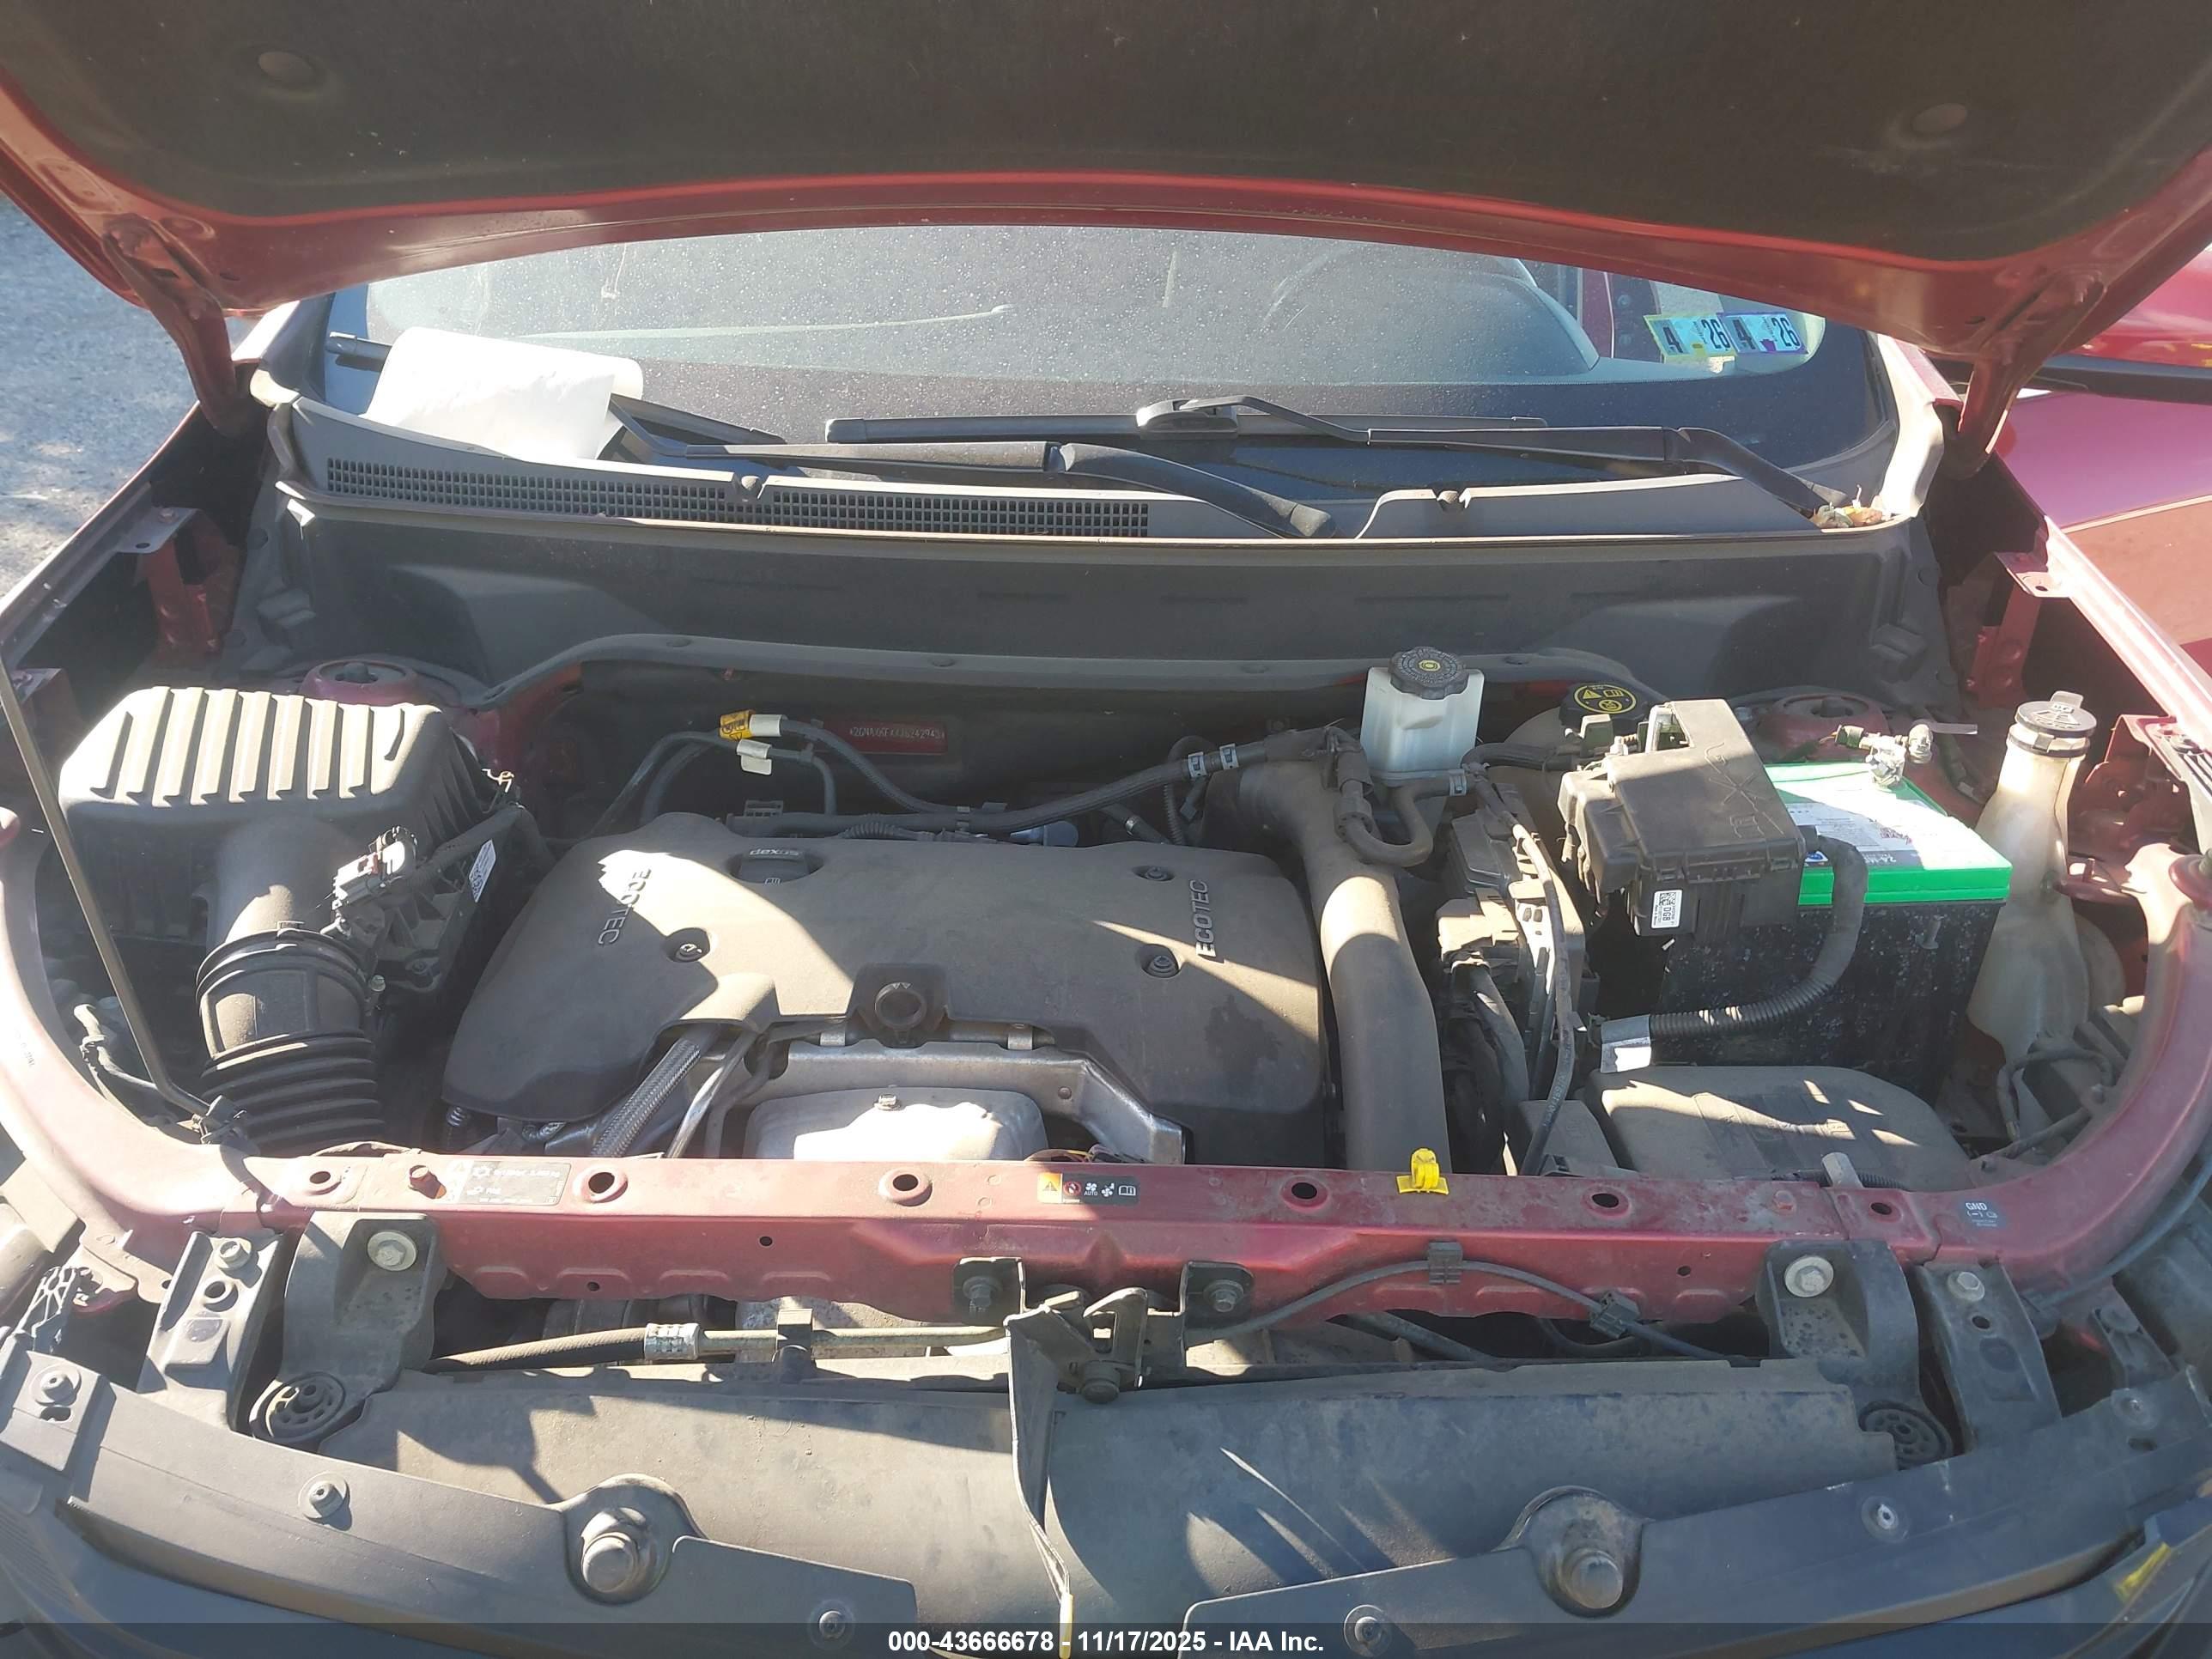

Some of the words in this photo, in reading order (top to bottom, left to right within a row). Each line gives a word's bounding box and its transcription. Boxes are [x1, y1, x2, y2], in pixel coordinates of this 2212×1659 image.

[1662, 326, 1683, 353] 4
[1701, 319, 1731, 349] 26
[1732, 319, 1756, 349] 4
[1772, 318, 1801, 348] 26
[599, 868, 652, 945] ECOTEC
[1190, 879, 1217, 957] ECOTEC
